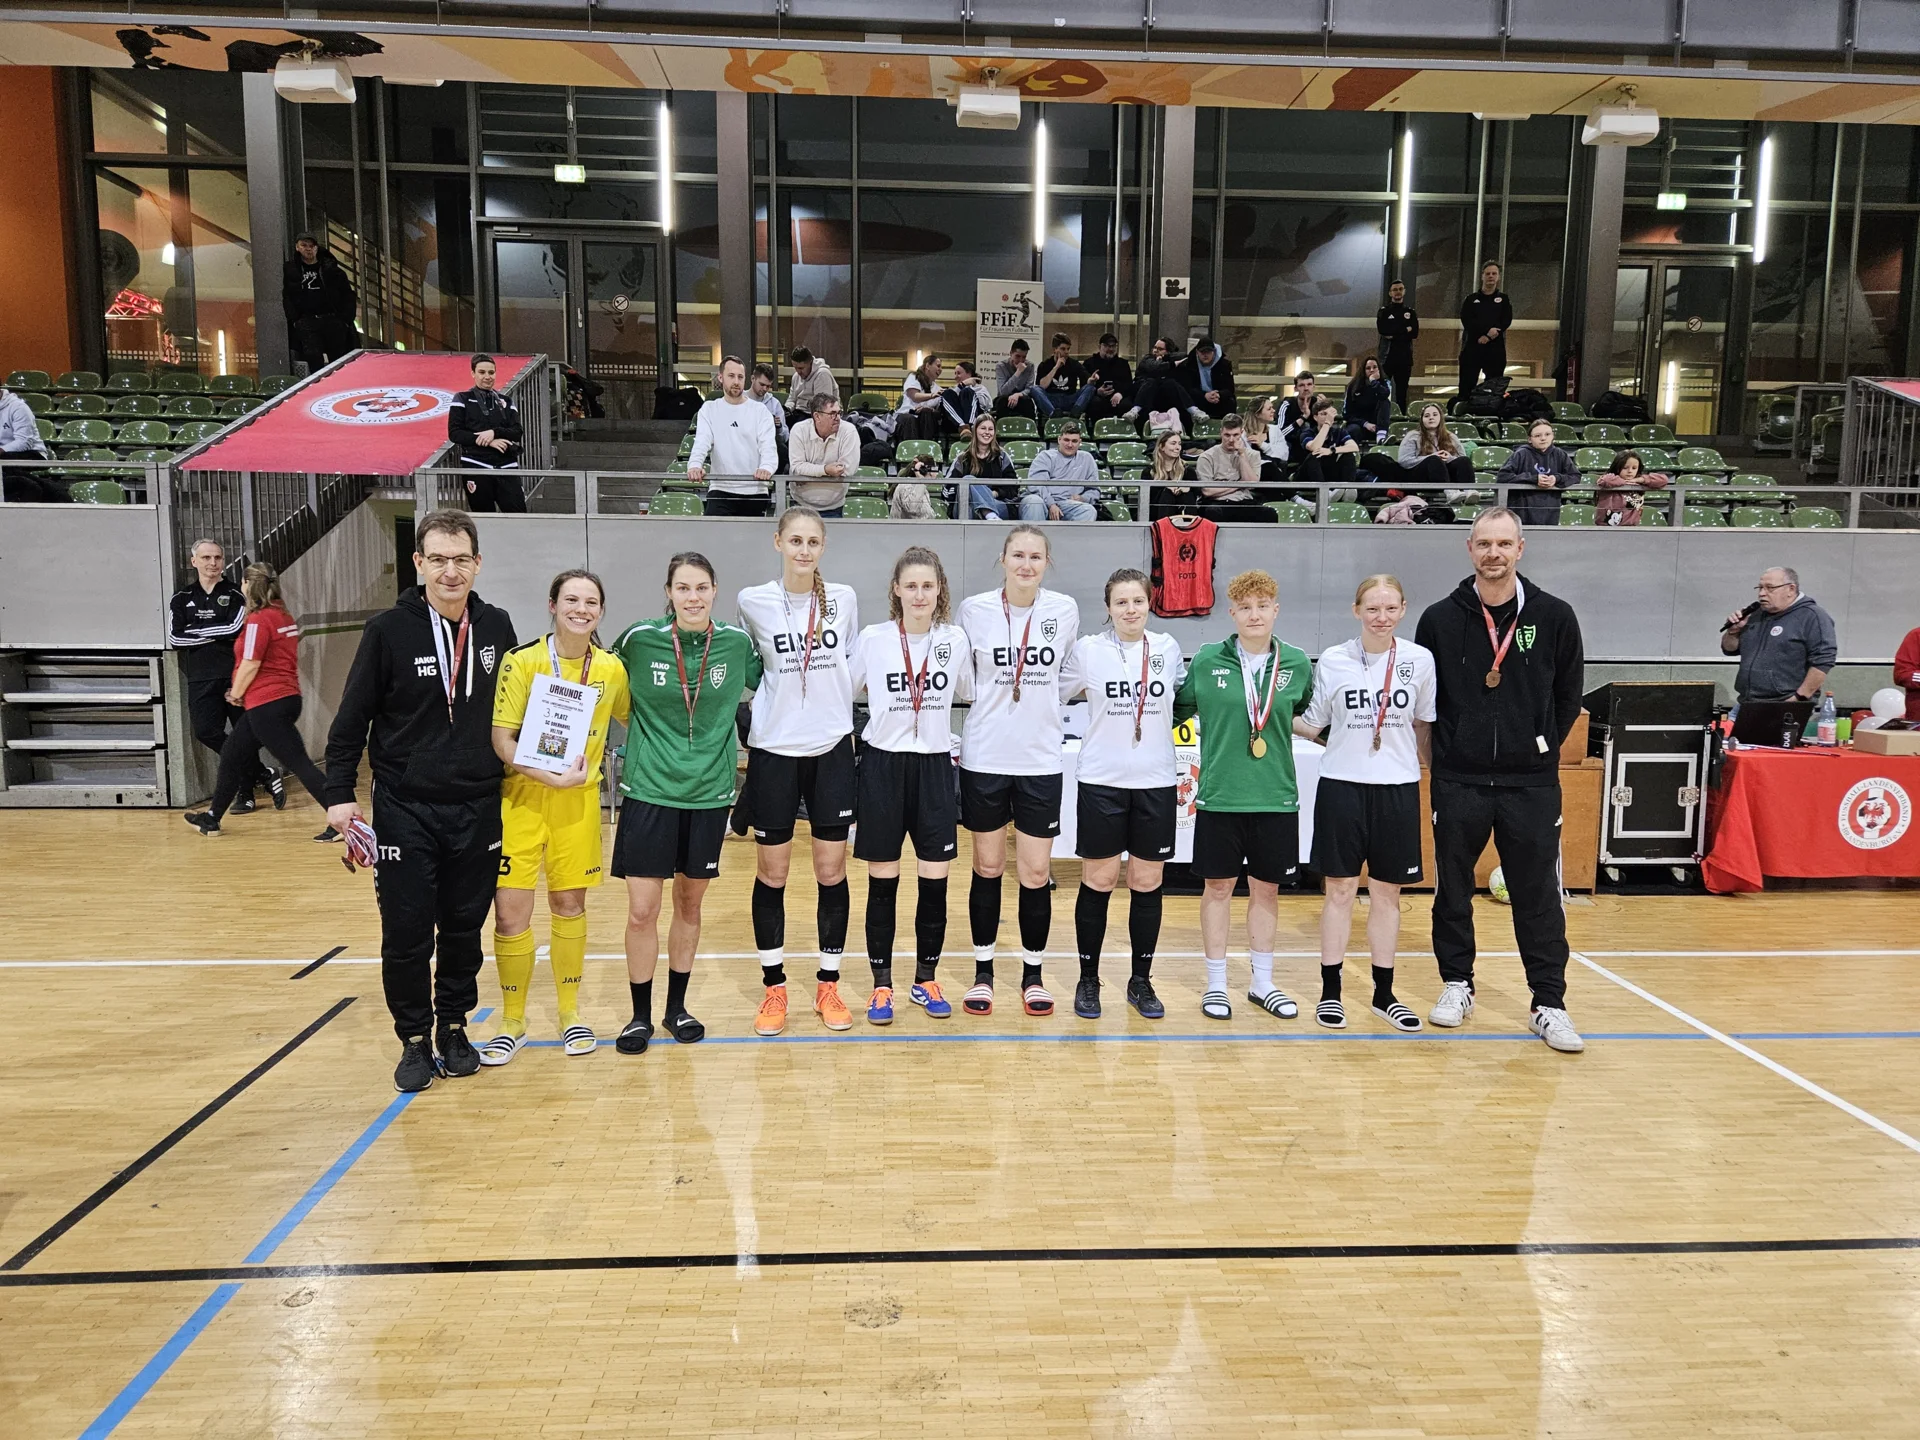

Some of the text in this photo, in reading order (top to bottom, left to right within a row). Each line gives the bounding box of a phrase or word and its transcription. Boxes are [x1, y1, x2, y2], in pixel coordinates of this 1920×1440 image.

[980, 312, 1017, 327] FFiF
[414, 656, 437, 665] JAKO
[938, 651, 948, 659] SC
[417, 666, 437, 676] HG
[650, 661, 670, 670] JAKO
[653, 670, 666, 686] 13
[712, 672, 723, 681] SC
[1400, 669, 1411, 678] SC
[1218, 677, 1227, 689] 4
[1276, 676, 1287, 685] SC
[549, 684, 583, 700] URKUNDE
[1345, 689, 1409, 709] ERGO
[554, 712, 568, 721] PLATZ
[1179, 724, 1191, 742] 0
[1840, 780, 1908, 822] FUSSBALL-LANDESVERBAND
[1842, 826, 1892, 848] BRANDENBURG
[488, 840, 501, 851] JAKO
[378, 845, 401, 861] TR
[584, 866, 601, 875] JAKO
